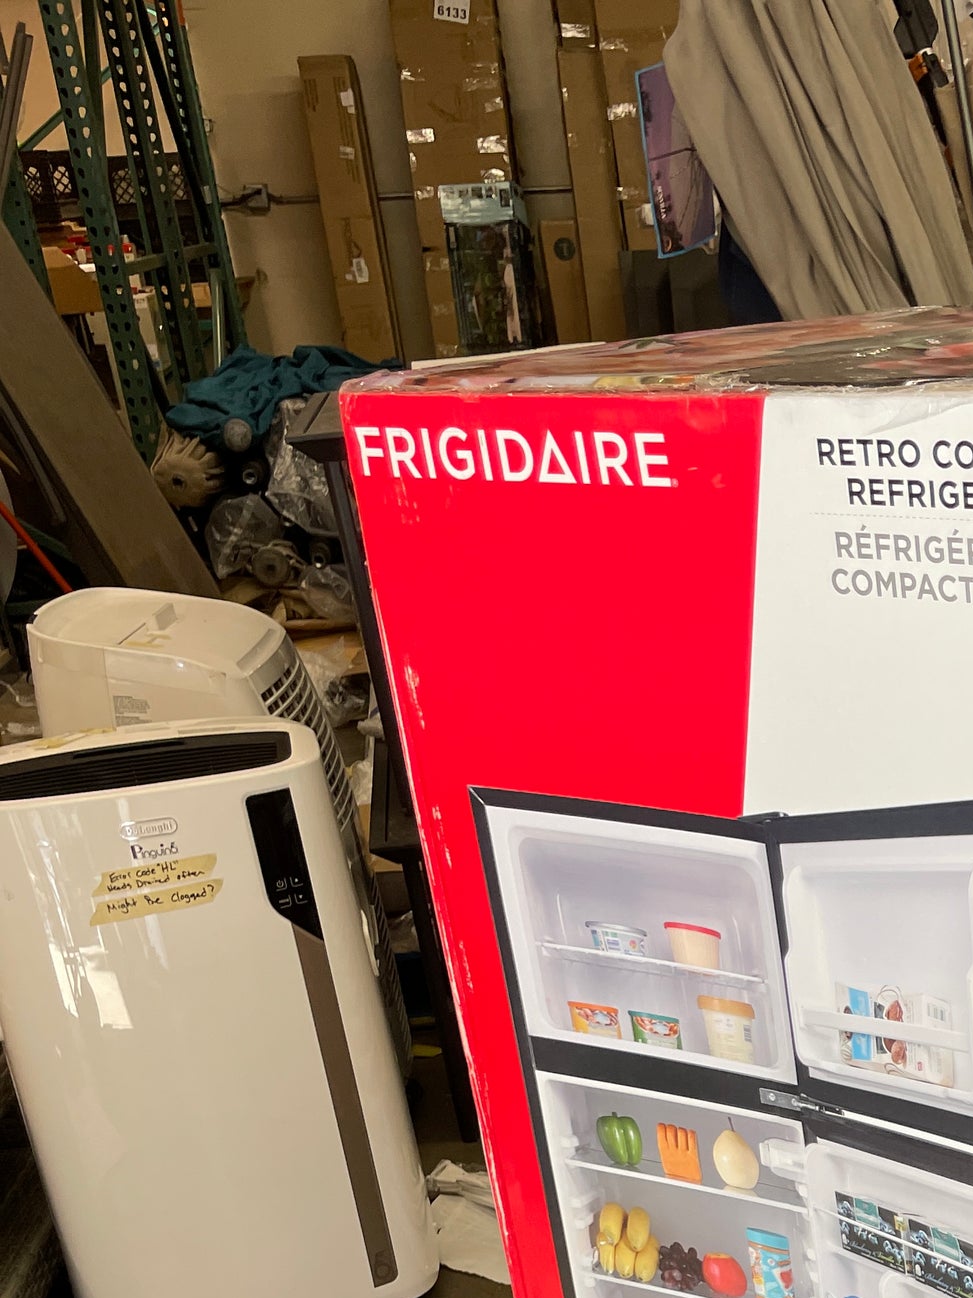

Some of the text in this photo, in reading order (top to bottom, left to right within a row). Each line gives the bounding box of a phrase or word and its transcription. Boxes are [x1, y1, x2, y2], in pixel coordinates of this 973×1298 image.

[437, 5, 467, 20] 6133
[354, 426, 673, 488] FRIGIDAIRE
[817, 436, 921, 470] RETRO
[107, 898, 138, 916] Might
